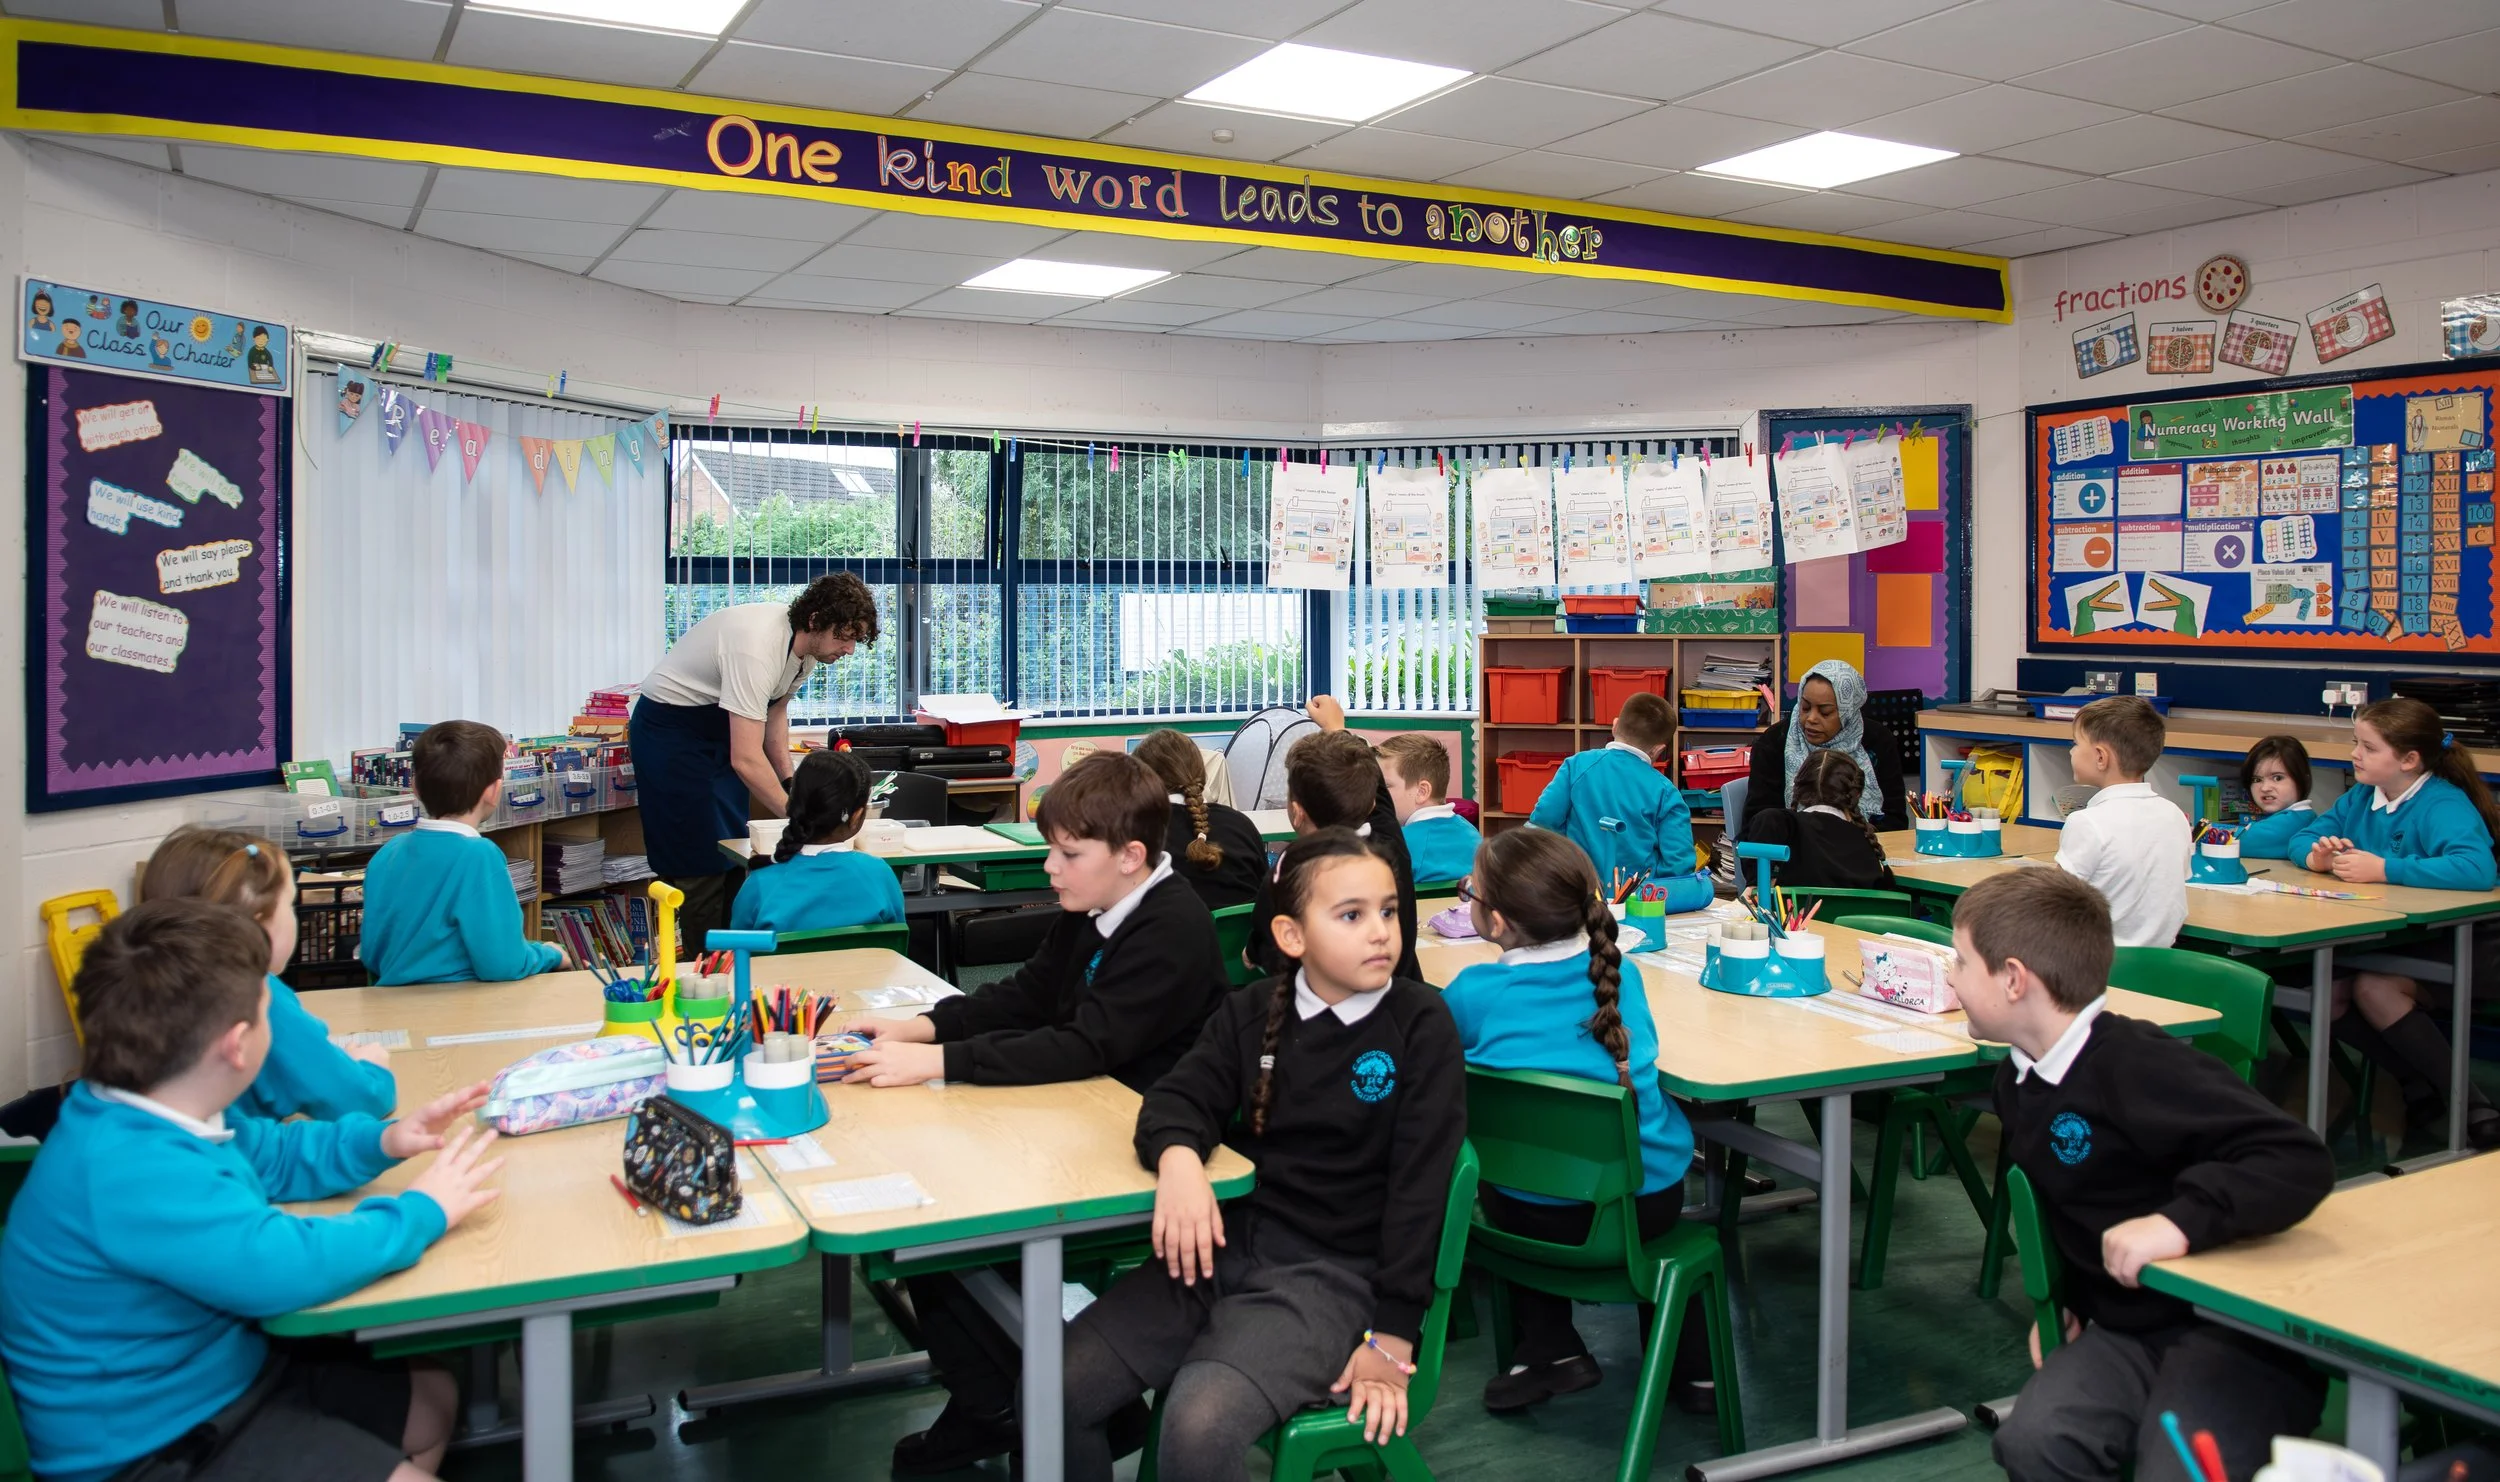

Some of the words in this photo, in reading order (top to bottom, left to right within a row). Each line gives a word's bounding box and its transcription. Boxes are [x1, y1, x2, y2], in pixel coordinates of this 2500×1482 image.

[706, 113, 843, 184] One
[877, 134, 1013, 198] kind
[1042, 164, 1190, 218] word
[1357, 194, 1403, 237] to
[1425, 203, 1603, 265] another
[2055, 275, 2187, 322] fractions
[2335, 298, 2359, 312] quarter
[146, 310, 184, 333] Our
[2255, 319, 2279, 330] quarters
[87, 330, 147, 356] Class
[172, 342, 236, 369] Charter
[81, 413, 97, 424] We
[101, 409, 117, 421] will
[119, 407, 135, 421] get
[2144, 421, 2217, 438] Numeracy
[2222, 414, 2287, 432] Working
[2292, 407, 2335, 426] Wall
[108, 427, 131, 441] each
[2231, 433, 2261, 446] thoughts
[2409, 478, 2425, 491] 12
[2436, 478, 2457, 490] XII
[94, 485, 113, 500] We
[116, 493, 134, 508] will
[136, 502, 154, 515] use
[156, 504, 179, 522] kind
[2409, 498, 2424, 511] 13
[2435, 499, 2456, 509] XIII
[2352, 514, 2359, 525] 4
[2376, 512, 2392, 524] IV
[2469, 507, 2494, 520] 100
[2188, 523, 2240, 532] multiplication
[2409, 517, 2424, 529] 14
[2435, 517, 2457, 528] XIV
[2057, 525, 2097, 534] subtraction
[2475, 529, 2486, 542] C
[2352, 533, 2360, 544] 5
[2377, 531, 2388, 542] V
[2409, 538, 2424, 549] 15
[2436, 538, 2457, 550] XV
[160, 555, 179, 567] We
[181, 551, 199, 564] will
[201, 549, 218, 561] say
[221, 542, 250, 560] please
[2352, 553, 2359, 564] 6
[2376, 553, 2391, 563] VI
[2409, 560, 2424, 571] 16
[2435, 560, 2458, 570] XVI
[163, 576, 182, 589] and
[185, 569, 214, 584] thank
[2353, 573, 2361, 586] 7
[2373, 573, 2394, 585] VII
[2408, 578, 2423, 591] 17
[2433, 579, 2456, 588] XVII
[2349, 593, 2359, 606] 8
[2374, 596, 2395, 606] VIII
[2409, 598, 2423, 611] 18
[2431, 599, 2454, 611] XVIII
[99, 595, 117, 609] We
[120, 600, 139, 614] will
[141, 604, 170, 622] listen
[173, 613, 183, 625] to
[2351, 612, 2359, 623] 9
[2409, 617, 2424, 628] 19
[93, 618, 113, 631] our
[116, 621, 164, 643] teachers
[165, 633, 183, 647] and
[88, 641, 108, 653] our
